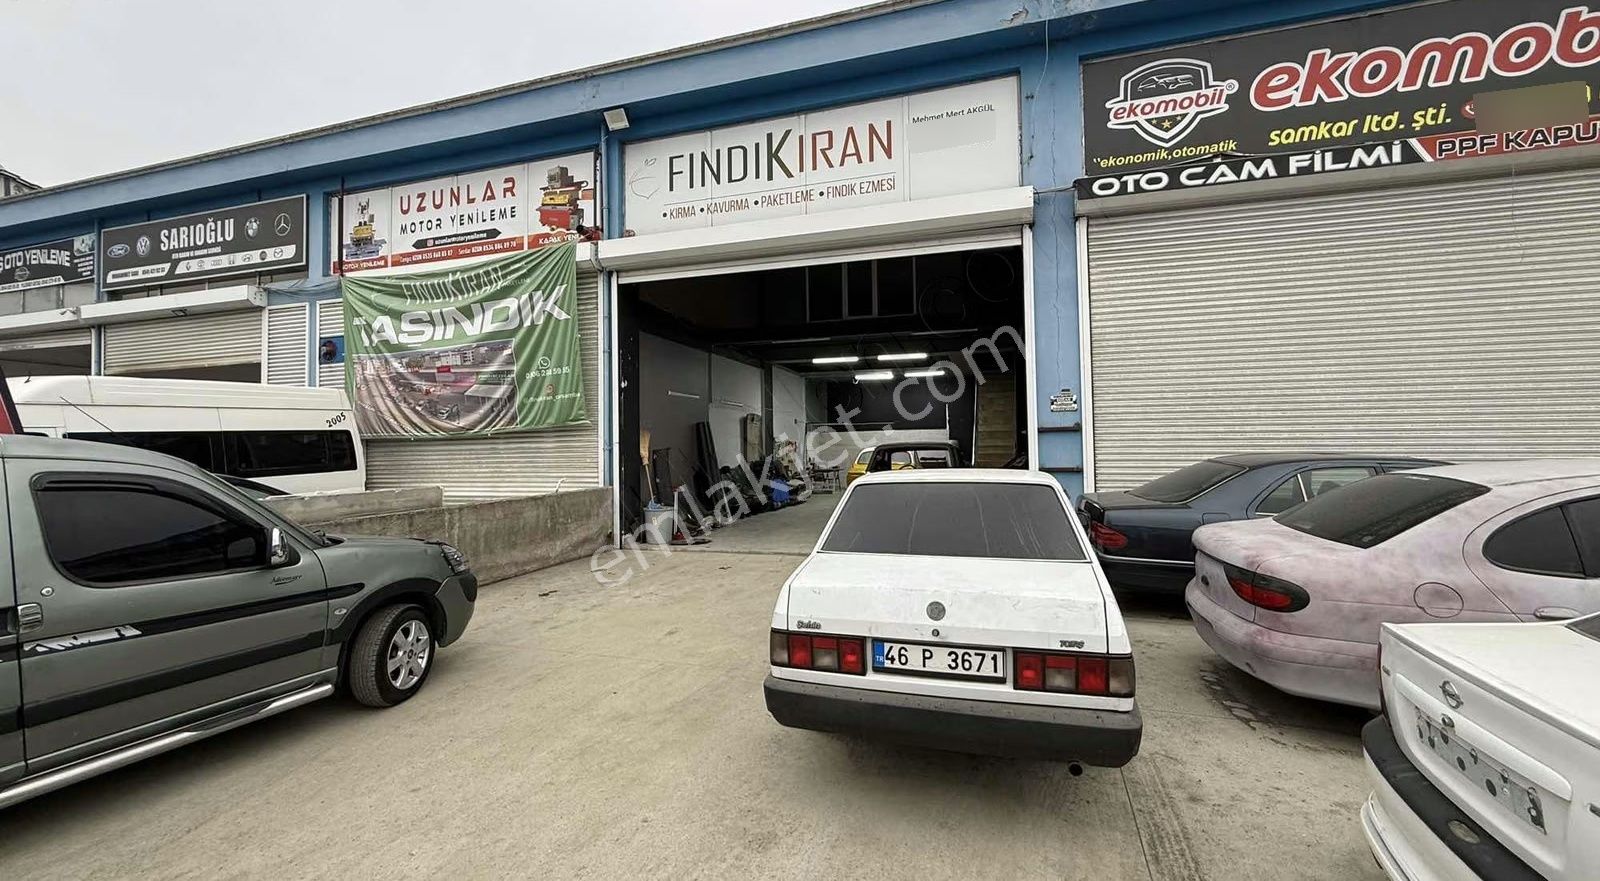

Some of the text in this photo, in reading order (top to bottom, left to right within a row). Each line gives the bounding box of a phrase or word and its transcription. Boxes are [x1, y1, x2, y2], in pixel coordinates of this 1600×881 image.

[912, 103, 995, 124] Mehmet Mert AKGÜL
[1113, 88, 1224, 120] ekomobil
[1268, 103, 1452, 146] samkar ltd. şti.
[1436, 121, 1600, 159] PPF KAPU
[668, 120, 893, 192] FINDIKIRAN
[1092, 171, 1169, 196] OTO
[1289, 140, 1402, 175] FİLMİ
[400, 176, 516, 216] UZUNLAR
[669, 175, 896, 220] KIRMA KAVURMA PAKETLEME FINDIK EZMESİ
[160, 217, 235, 251] SARIOĞLU
[400, 206, 517, 235] MOTOR YENİLEME
[4, 251, 24, 270] OTO
[326, 411, 347, 428] 2005
[885, 645, 908, 666] 46
[922, 648, 934, 668] P
[947, 650, 998, 674] 3671
